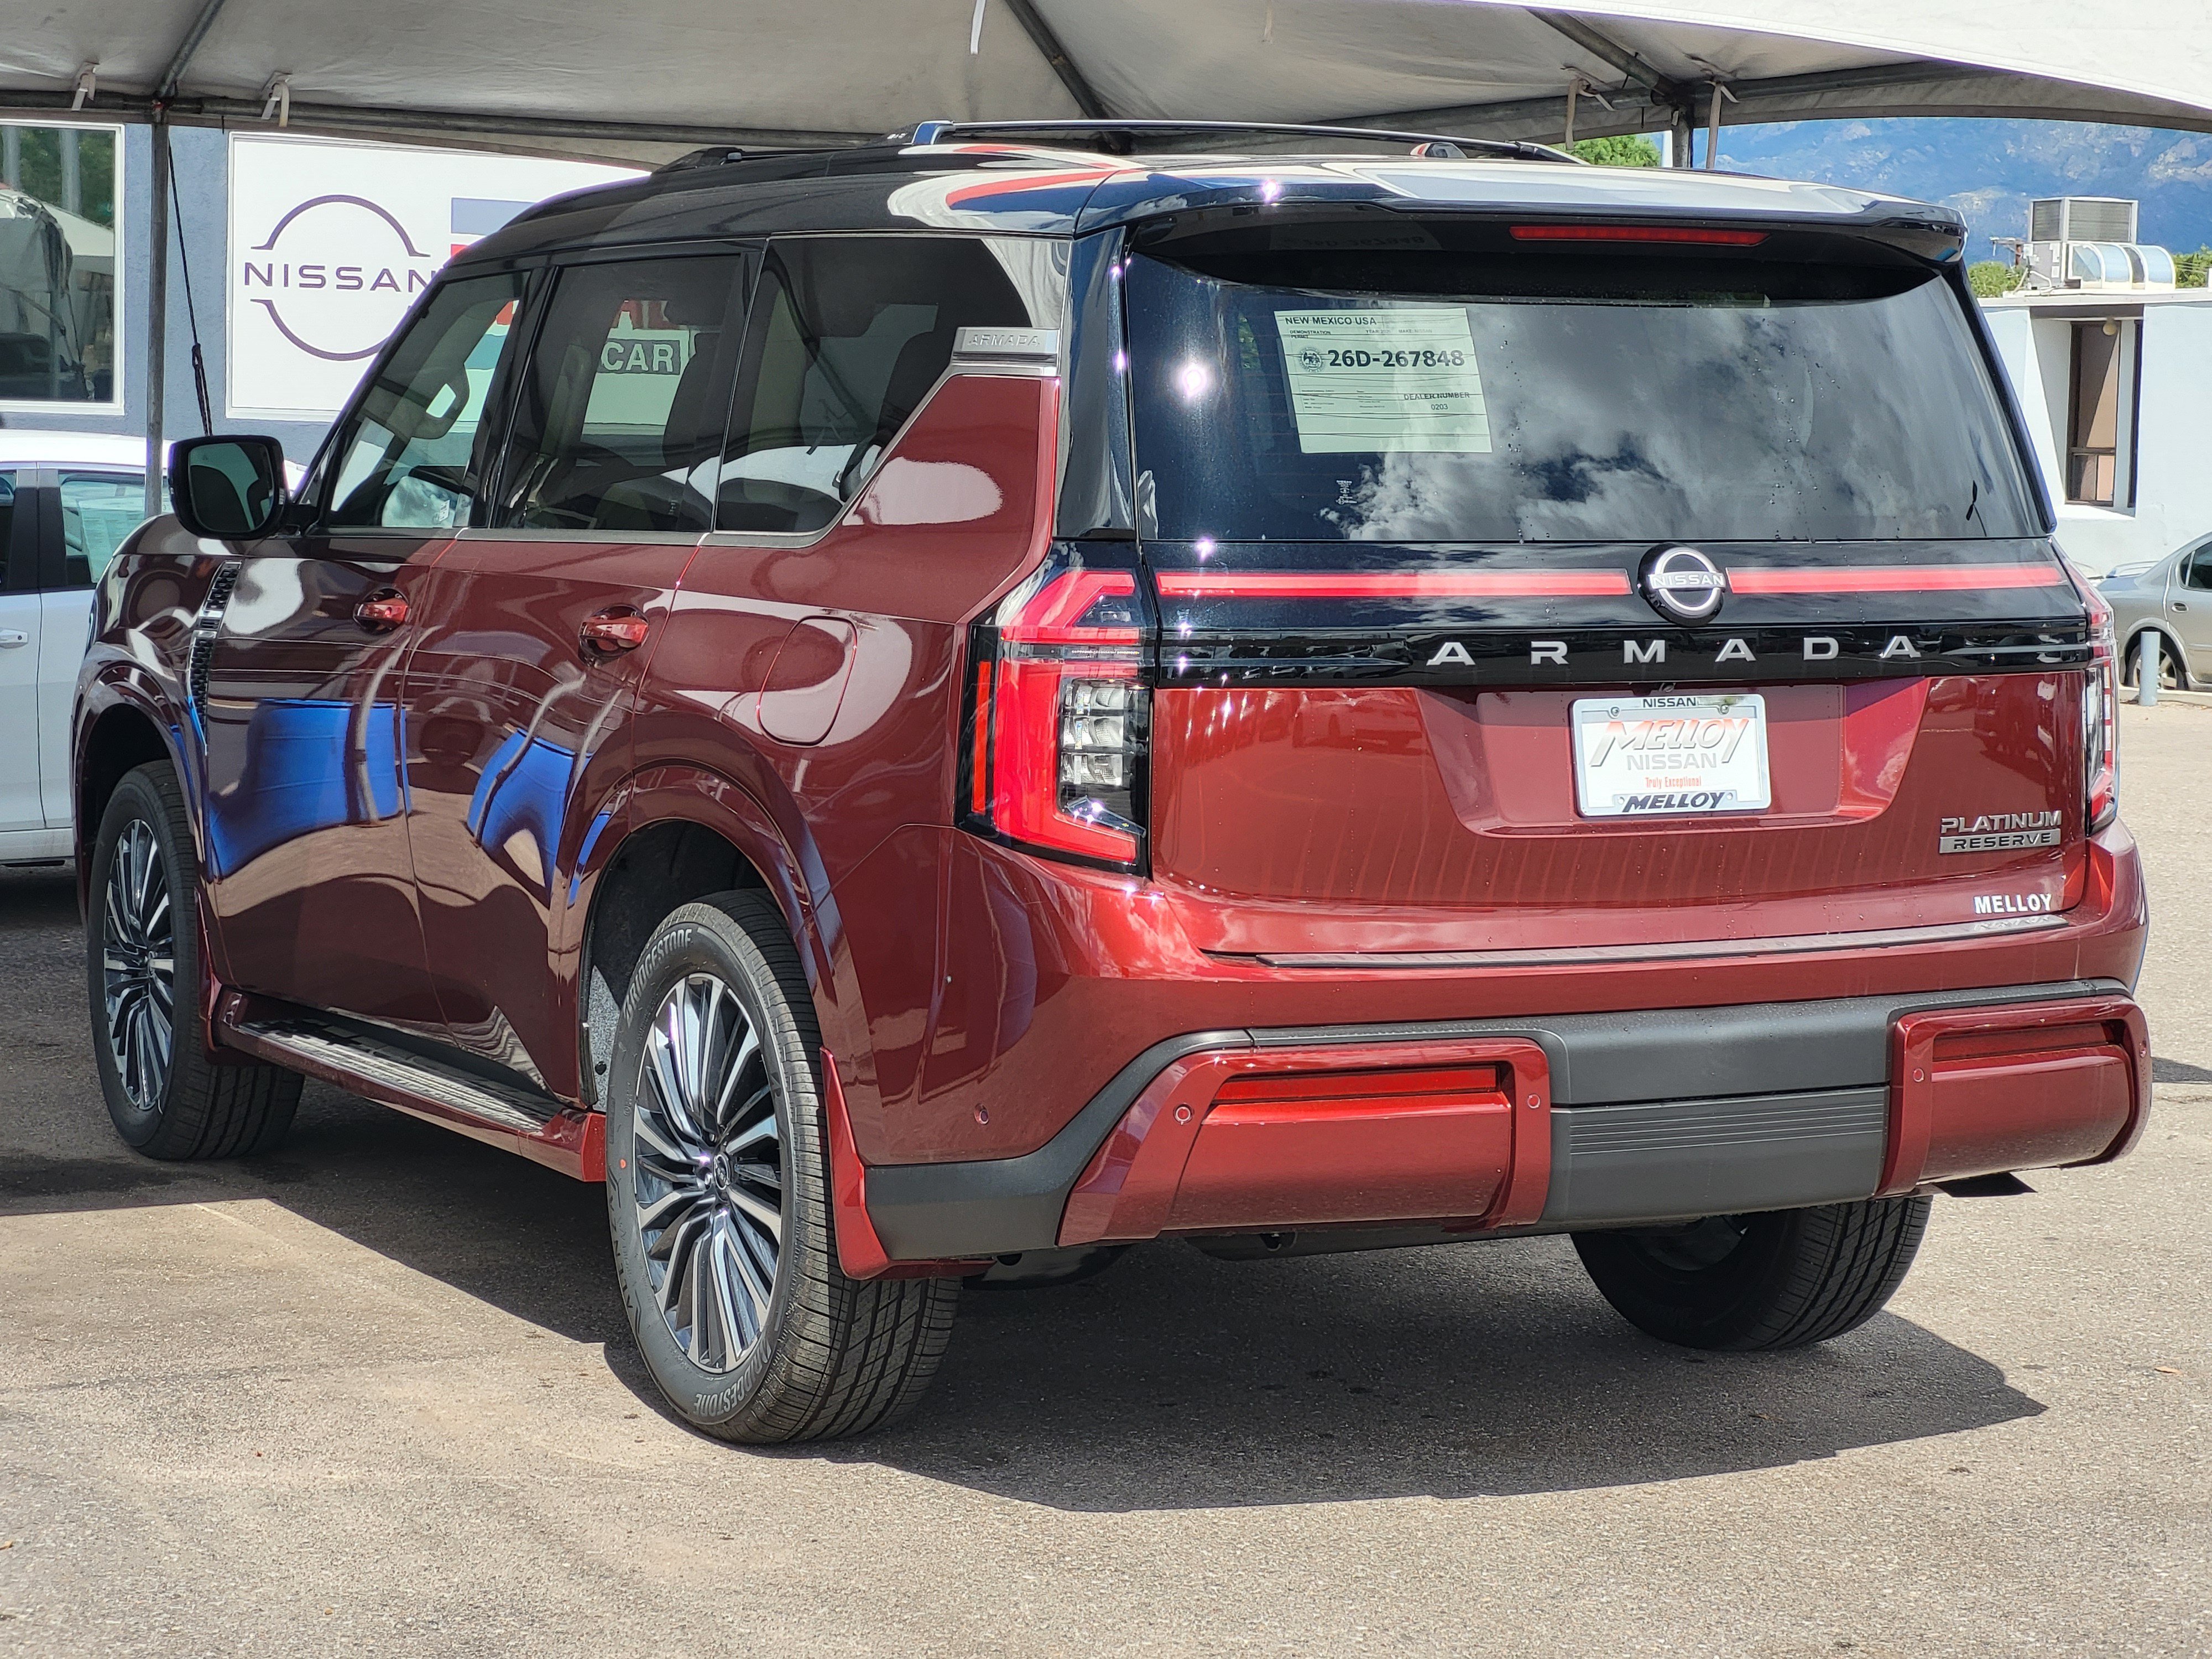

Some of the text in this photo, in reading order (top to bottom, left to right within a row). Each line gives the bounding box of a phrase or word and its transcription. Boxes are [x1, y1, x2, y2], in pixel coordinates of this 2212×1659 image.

[244, 262, 436, 293] NISSAN
[1355, 317, 1377, 325] USA
[968, 334, 1040, 346] ARMADA
[601, 341, 674, 372] CAR
[1327, 349, 1465, 367] 26D-267848
[1652, 574, 1725, 586] NISSAN
[1426, 635, 1921, 666] ARMADA
[1642, 697, 1697, 708] NISSAN
[1590, 718, 1749, 768] MELLOY
[1627, 753, 1717, 771] NISSAN
[1645, 776, 1702, 789] Truly Exceptional
[1621, 791, 1726, 813] MELLOY
[1940, 810, 2062, 834] PLATINUM
[1953, 833, 2051, 850] RESERVE
[1973, 893, 2052, 914] MELLOY
[623, 928, 692, 1029] BRIDGESTONE
